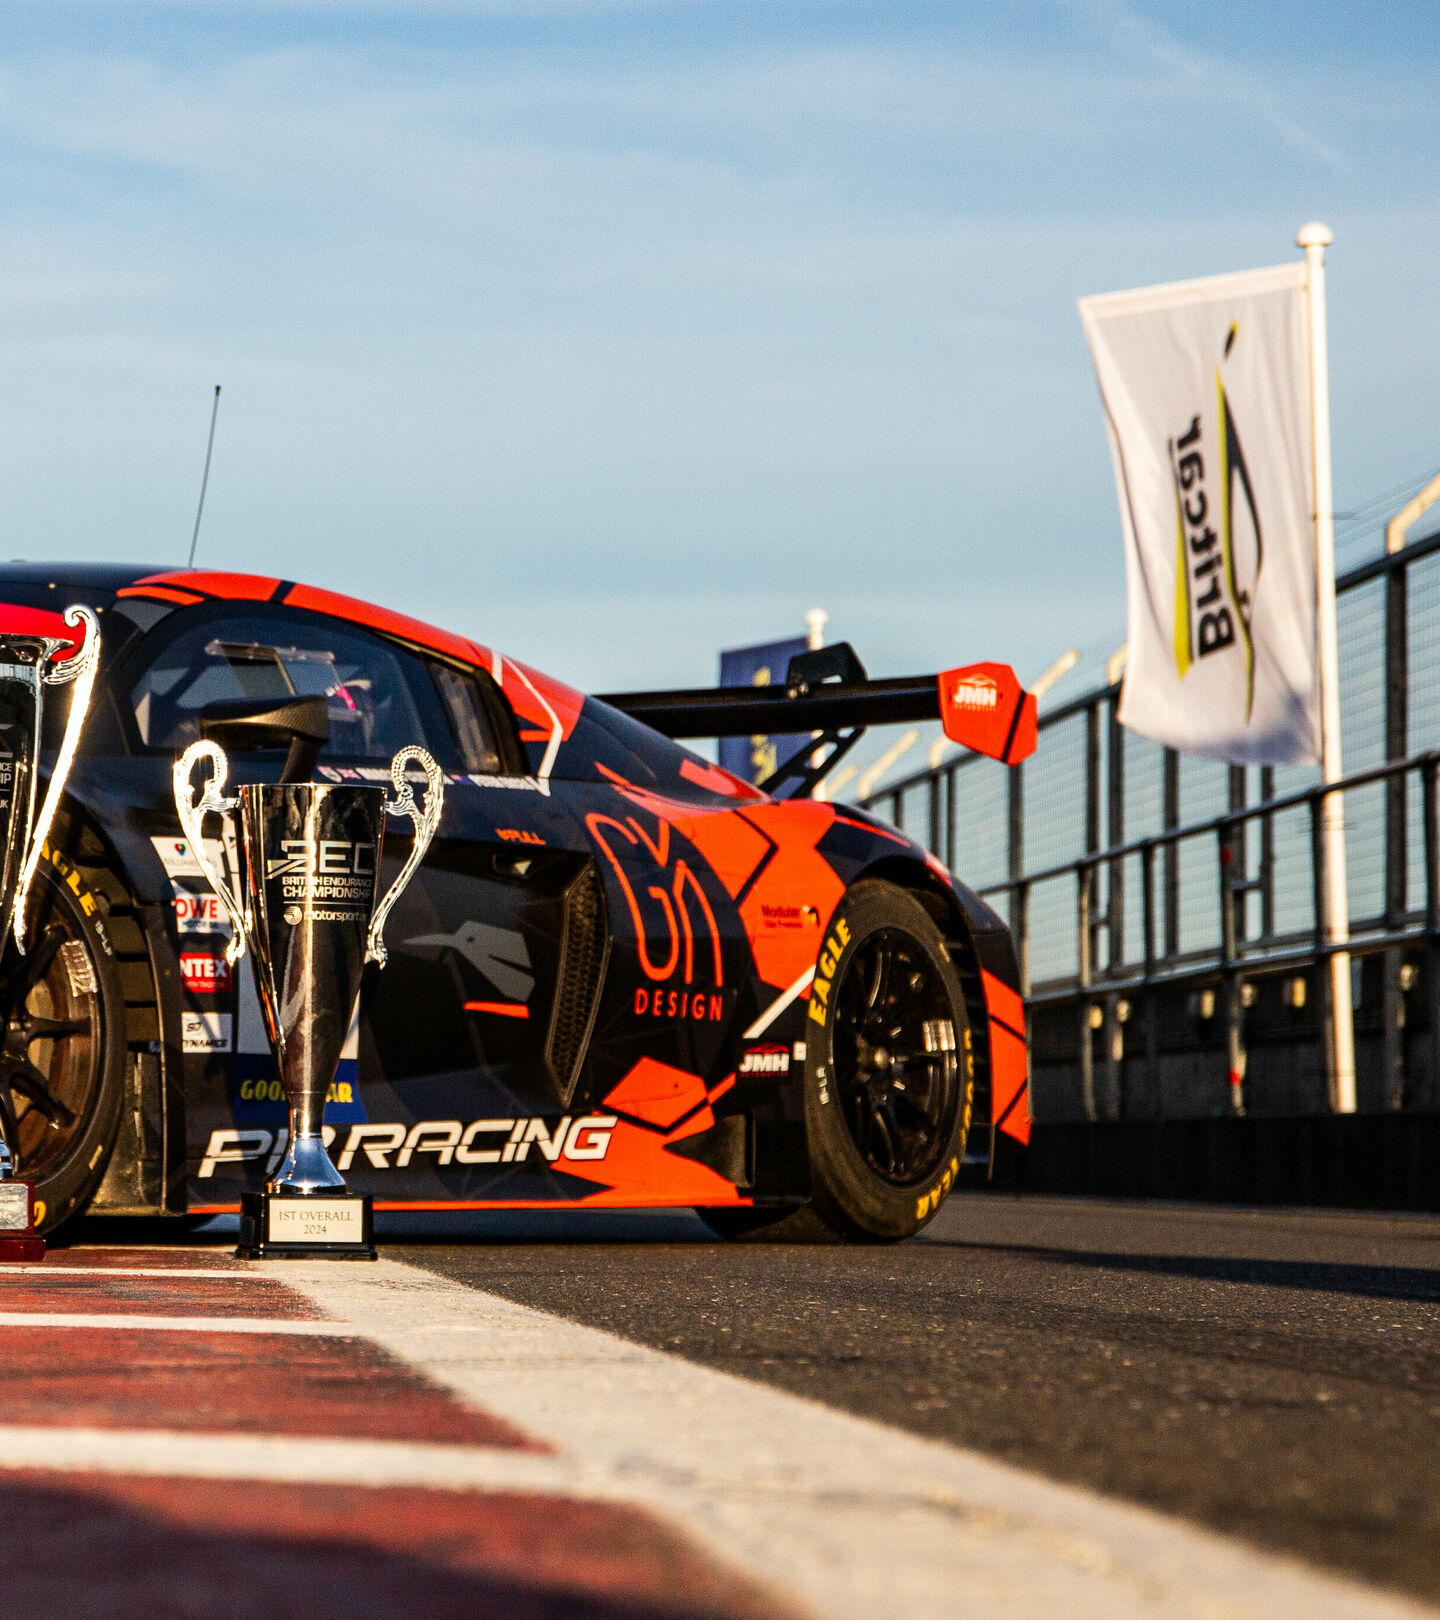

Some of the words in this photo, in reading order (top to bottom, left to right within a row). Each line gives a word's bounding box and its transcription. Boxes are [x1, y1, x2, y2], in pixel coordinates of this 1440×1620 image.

[953, 684, 997, 706] JMH
[283, 886, 372, 898] CHAMPIONSHIP
[174, 898, 219, 919] OWE
[180, 958, 227, 978] NTEX
[808, 917, 852, 1027] EAGLE
[633, 987, 723, 1022] DESIGN
[739, 1053, 790, 1073] JMH
[240, 1080, 353, 1103] GOOAR
[337, 1114, 618, 1171] RACING
[278, 1211, 297, 1221] 1ST
[302, 1211, 354, 1222] OVERALL
[303, 1224, 328, 1236] 2024
